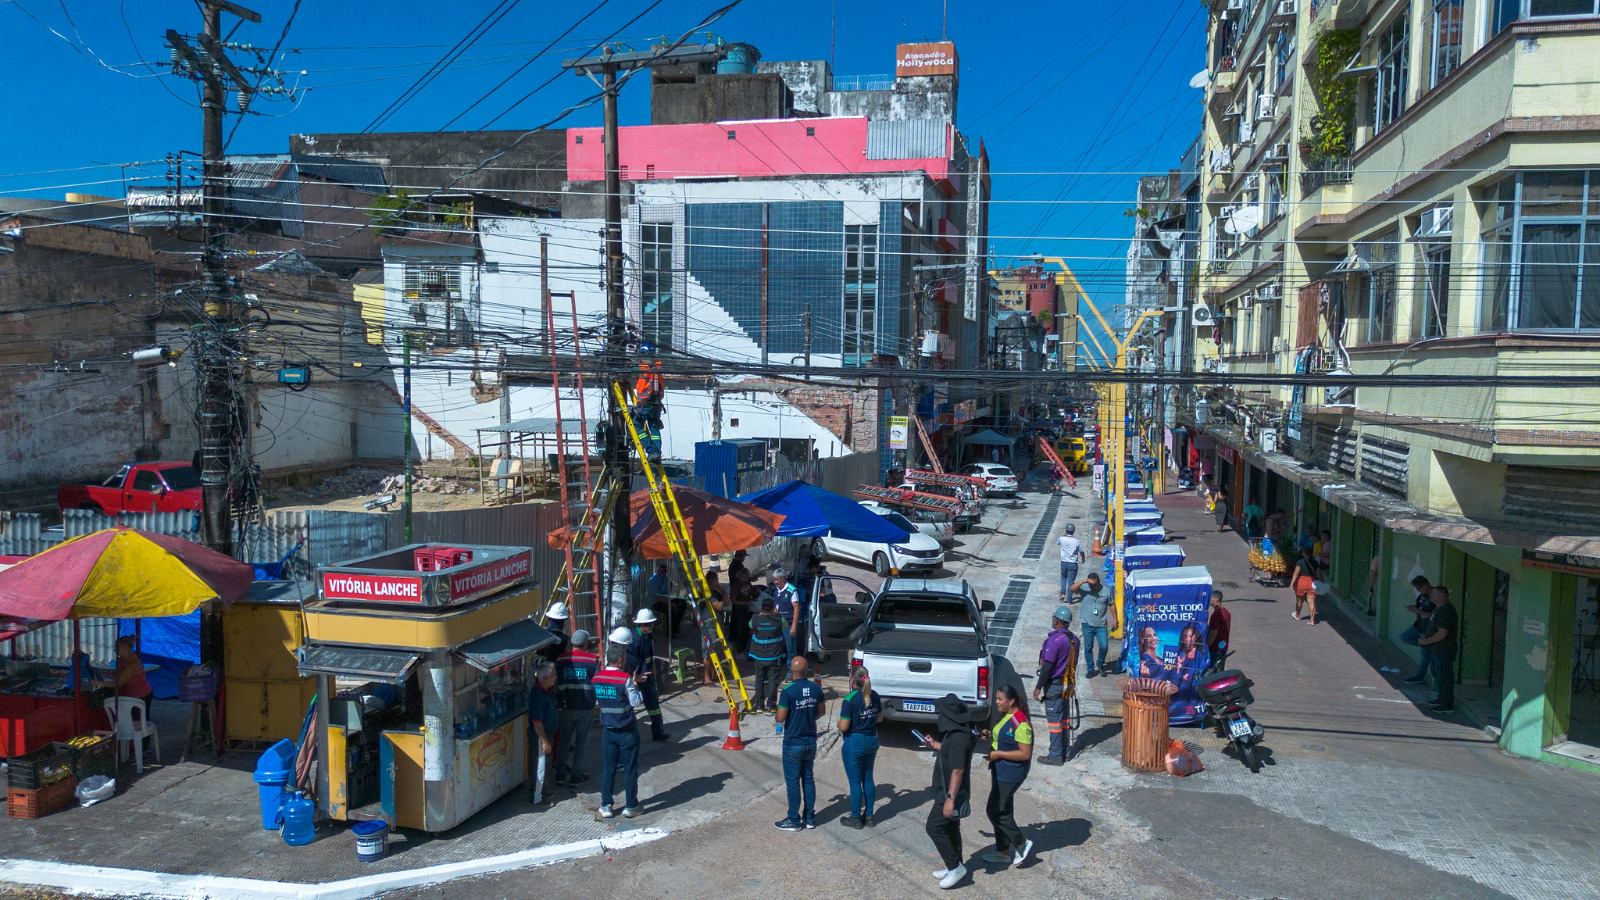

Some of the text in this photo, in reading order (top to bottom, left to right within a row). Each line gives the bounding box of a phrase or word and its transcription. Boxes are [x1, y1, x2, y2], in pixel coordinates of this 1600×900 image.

[897, 58, 954, 67] Hollywood
[455, 560, 528, 593] VITÓRIA LANCHE
[328, 577, 418, 597] VITÓRIA LANCHE
[1142, 603, 1158, 613] PRÉ
[1159, 604, 1178, 613] QUE
[1180, 603, 1203, 612] TODO
[875, 673, 966, 681] CHEVROLET
